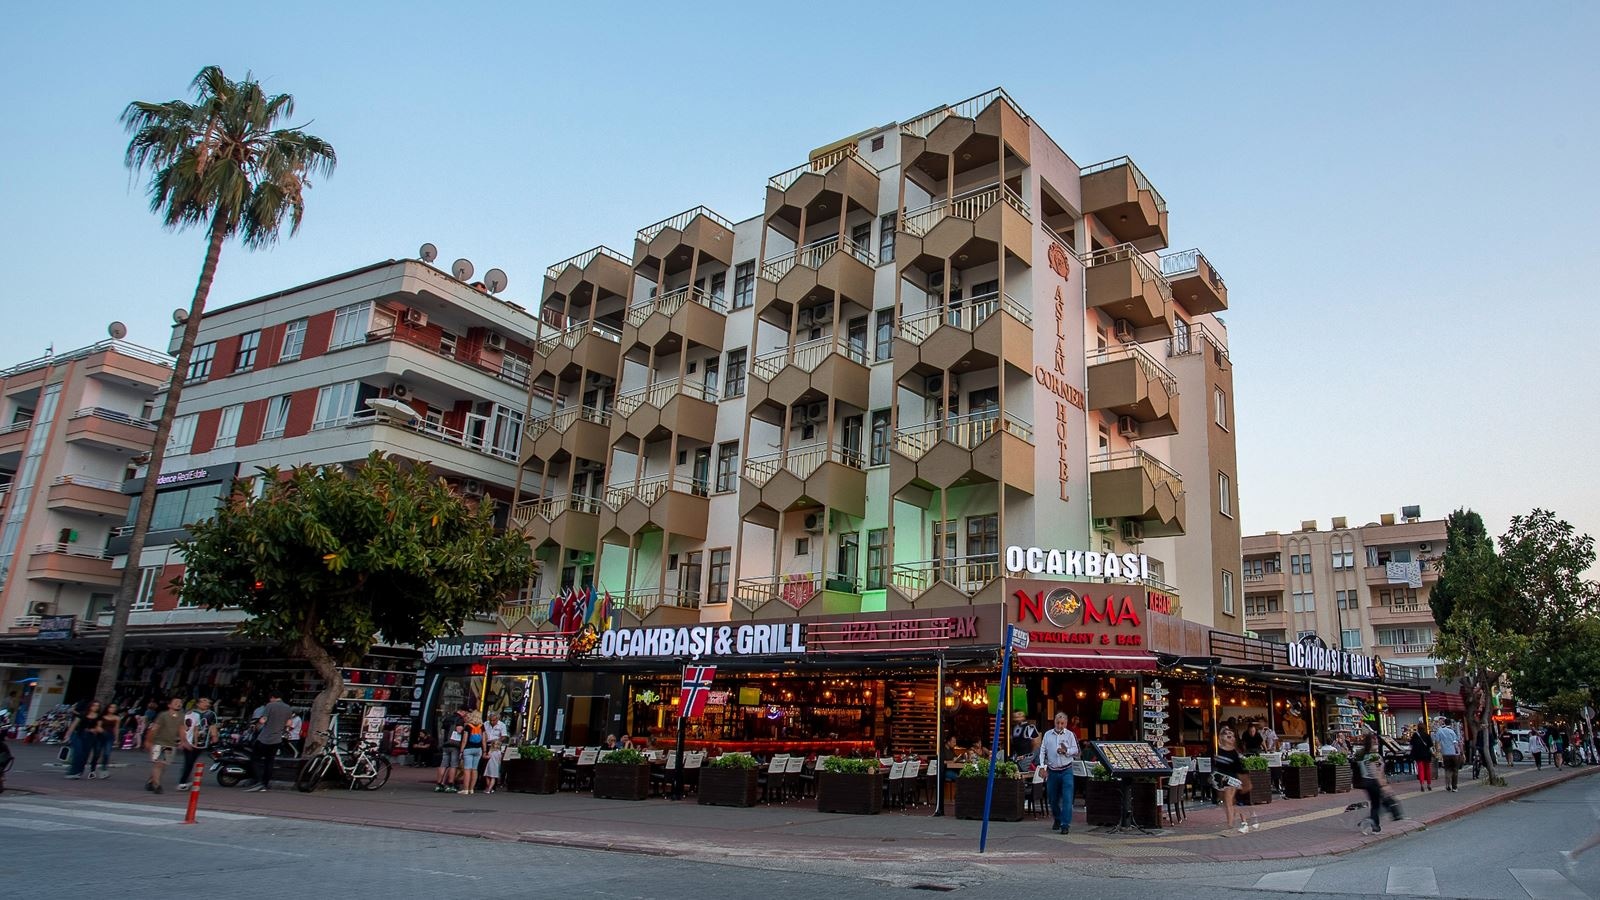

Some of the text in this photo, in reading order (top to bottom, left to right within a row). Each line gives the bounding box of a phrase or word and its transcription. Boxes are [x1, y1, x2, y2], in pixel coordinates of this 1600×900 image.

[1054, 285, 1065, 375] ASLAN
[1035, 364, 1085, 412] CORNER
[1055, 401, 1070, 502] HOTEL
[1006, 545, 1149, 583] OCAKBAŞI
[601, 623, 806, 661] OCAKBAŞI & GRILL
[840, 616, 978, 641] PIZZA FISH STEAK
[1029, 630, 1095, 645] STAURANT
[1101, 633, 1111, 645] &
[1116, 634, 1142, 646] BAR
[462, 642, 471, 656] &
[1289, 642, 1341, 676] OCAKBAŞI
[1343, 651, 1349, 674] &
[1350, 653, 1375, 677] GRILL
